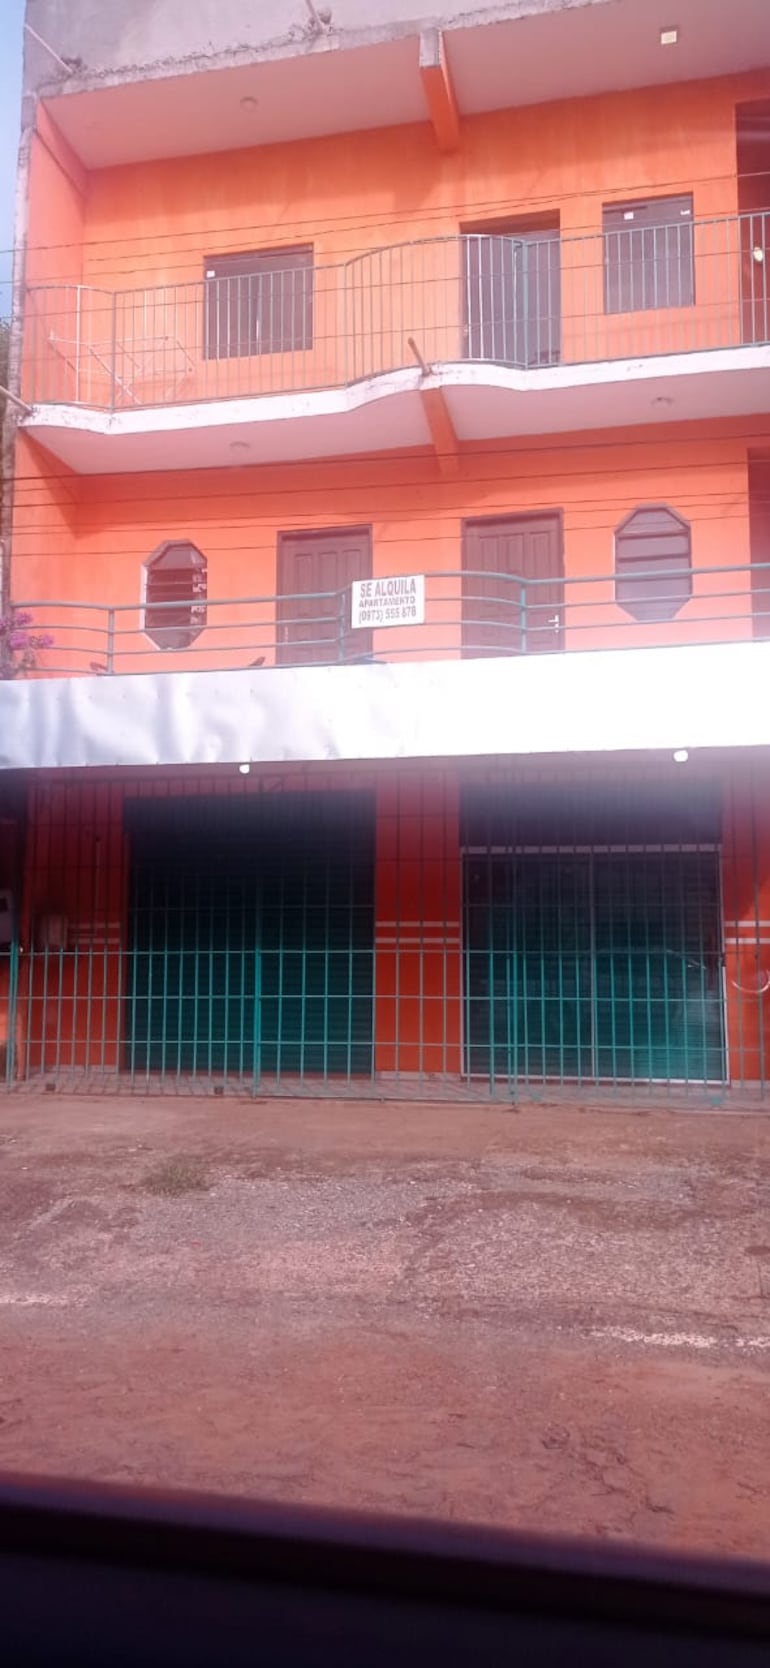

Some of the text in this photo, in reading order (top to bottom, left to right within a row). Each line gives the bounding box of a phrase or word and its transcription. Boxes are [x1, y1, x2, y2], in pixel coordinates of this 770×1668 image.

[360, 578, 416, 598] SE ALQUILA
[359, 596, 415, 608] APARTAMENTO
